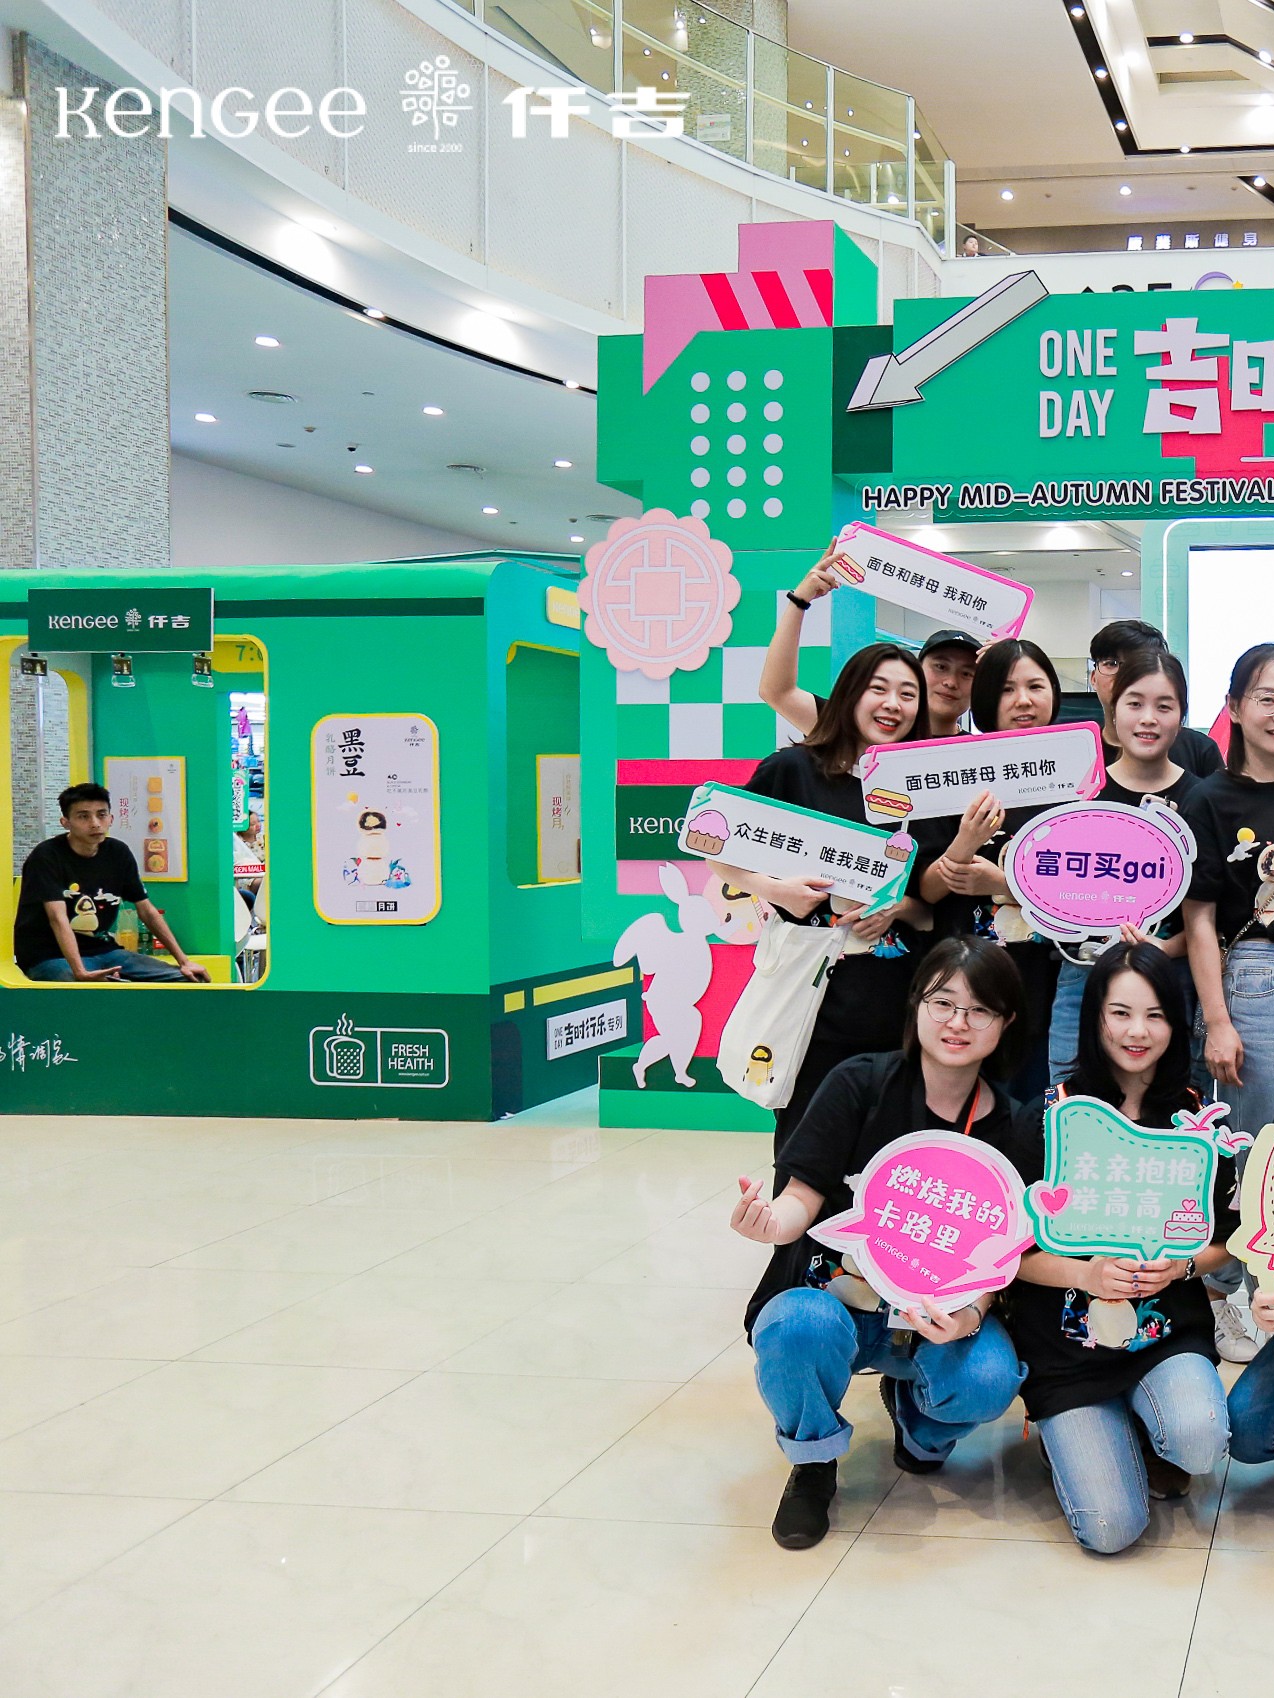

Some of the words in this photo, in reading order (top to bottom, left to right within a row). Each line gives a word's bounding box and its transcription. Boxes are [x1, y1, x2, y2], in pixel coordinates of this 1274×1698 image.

[1039, 329, 1117, 378] ONE
[1039, 389, 1114, 438] DAY
[863, 485, 951, 509] HAPPY
[866, 556, 940, 594] 面包和酵母
[943, 585, 988, 611] 我和你
[147, 615, 190, 629] 仟吉
[338, 727, 366, 777] 黑豆
[905, 765, 997, 791] 面包和酵母
[1003, 759, 1057, 780] 我和你
[734, 822, 889, 878] 众生皆苦，唯我是甜
[1036, 849, 1165, 883] 富可买gai
[378, 902, 398, 912] 月饼
[564, 1013, 606, 1046] 吉时行乐
[608, 1016, 623, 1031] 专列
[391, 1044, 429, 1057] FRESH
[1074, 1151, 1197, 1186] 亲亲抱抱
[886, 1165, 1006, 1230] 燃烧我的
[1072, 1186, 1164, 1218] 举高高
[874, 1200, 960, 1254] 卡路里
[920, 1267, 942, 1284] 仟吉
